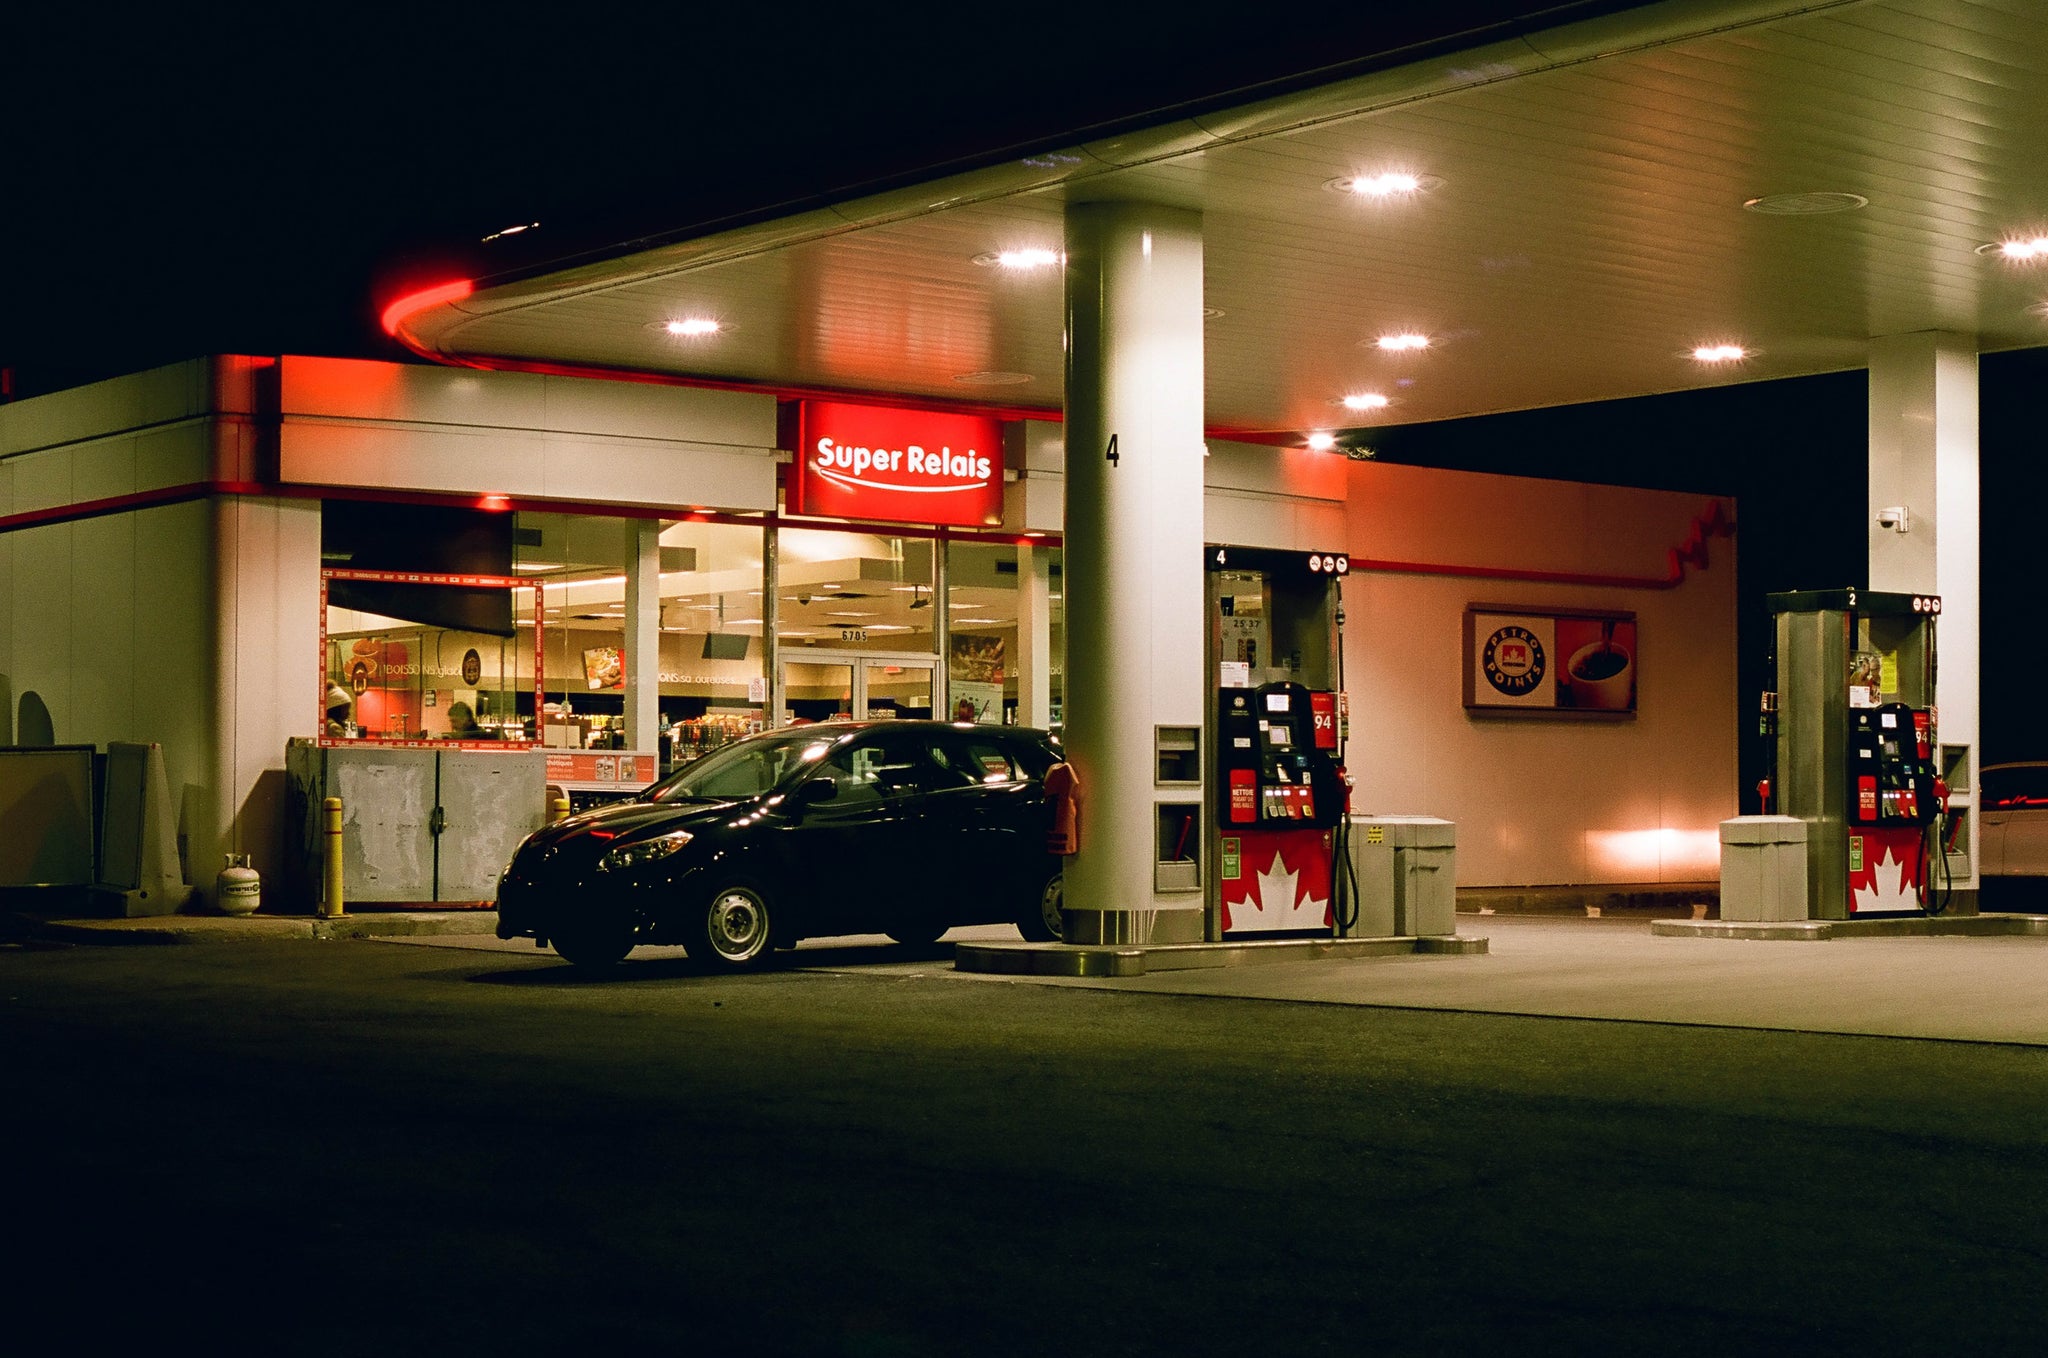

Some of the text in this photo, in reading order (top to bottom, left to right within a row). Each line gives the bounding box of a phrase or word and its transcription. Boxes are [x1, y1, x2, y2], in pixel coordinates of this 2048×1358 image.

[817, 437, 991, 480] Super Relais
[1106, 433, 1119, 468] 4
[1216, 549, 1226, 565] 4
[1848, 592, 1856, 606] 2
[842, 630, 867, 641] 6705
[1491, 629, 1538, 648] PETRO
[1488, 664, 1541, 687] POINTS
[1314, 715, 1331, 729] 94
[1915, 731, 1928, 743] 94
